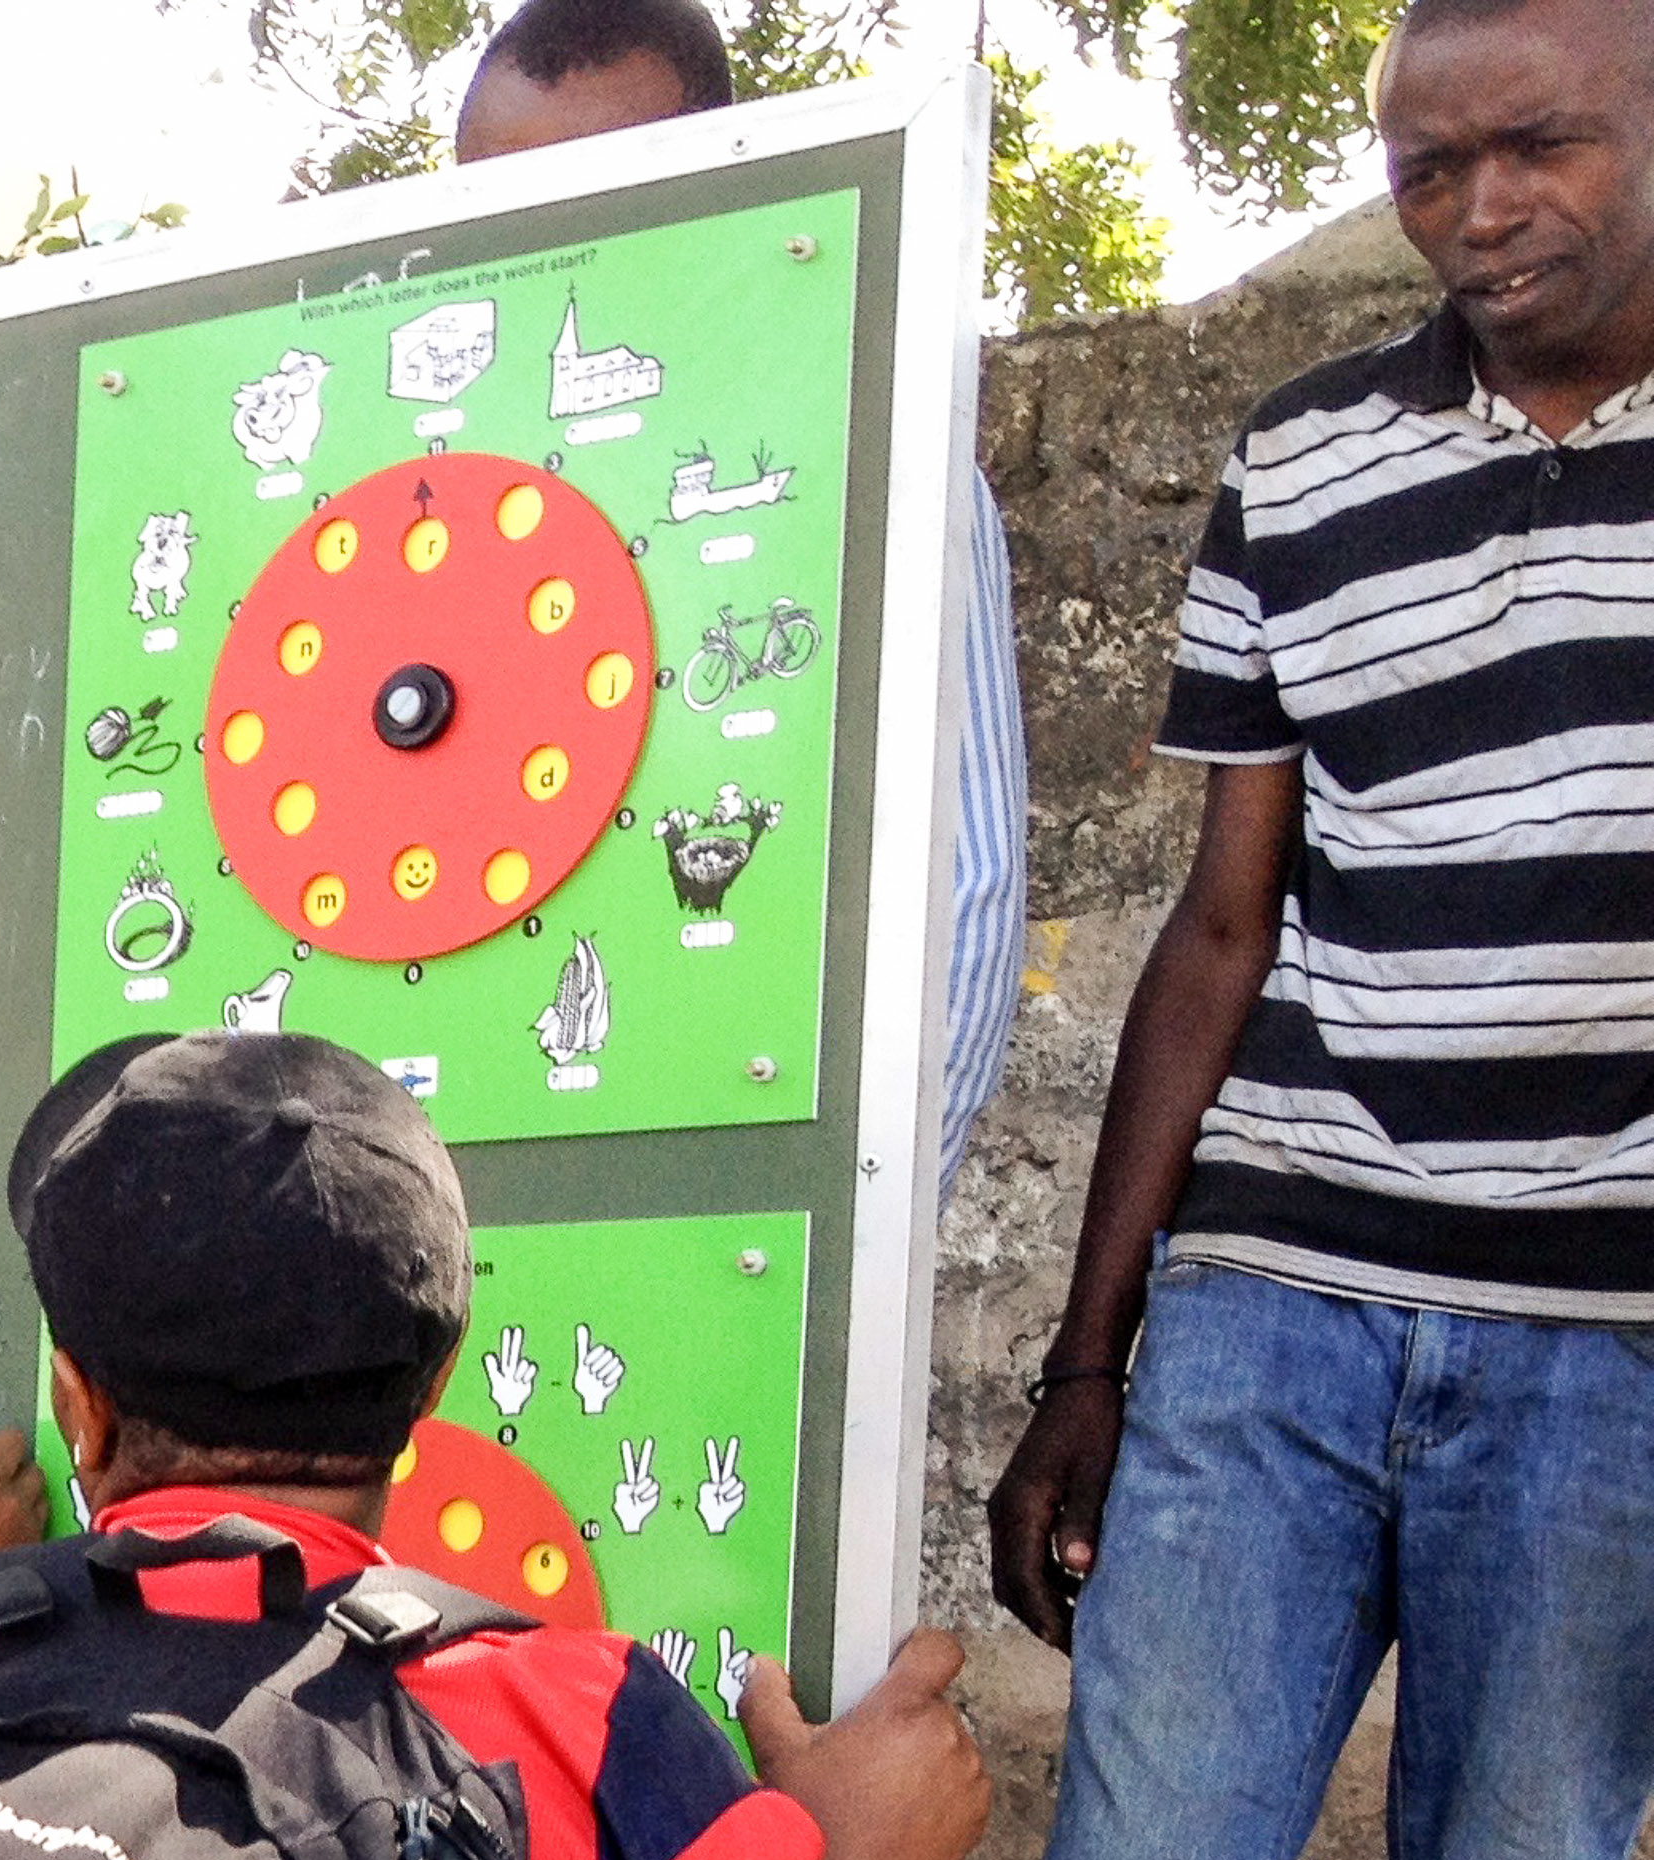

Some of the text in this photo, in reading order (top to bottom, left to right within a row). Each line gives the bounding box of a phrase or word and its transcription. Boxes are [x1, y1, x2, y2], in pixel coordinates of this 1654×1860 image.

[301, 248, 597, 322] With which letter does the word start?
[339, 536, 346, 554] t
[428, 537, 436, 555] r
[551, 600, 562, 619] b
[301, 641, 312, 657] n
[609, 674, 615, 700] j
[541, 767, 554, 788] d
[317, 894, 337, 910] m
[474, 1261, 493, 1276] on
[583, 1522, 600, 1539] 10
[541, 1552, 550, 1570] 6
